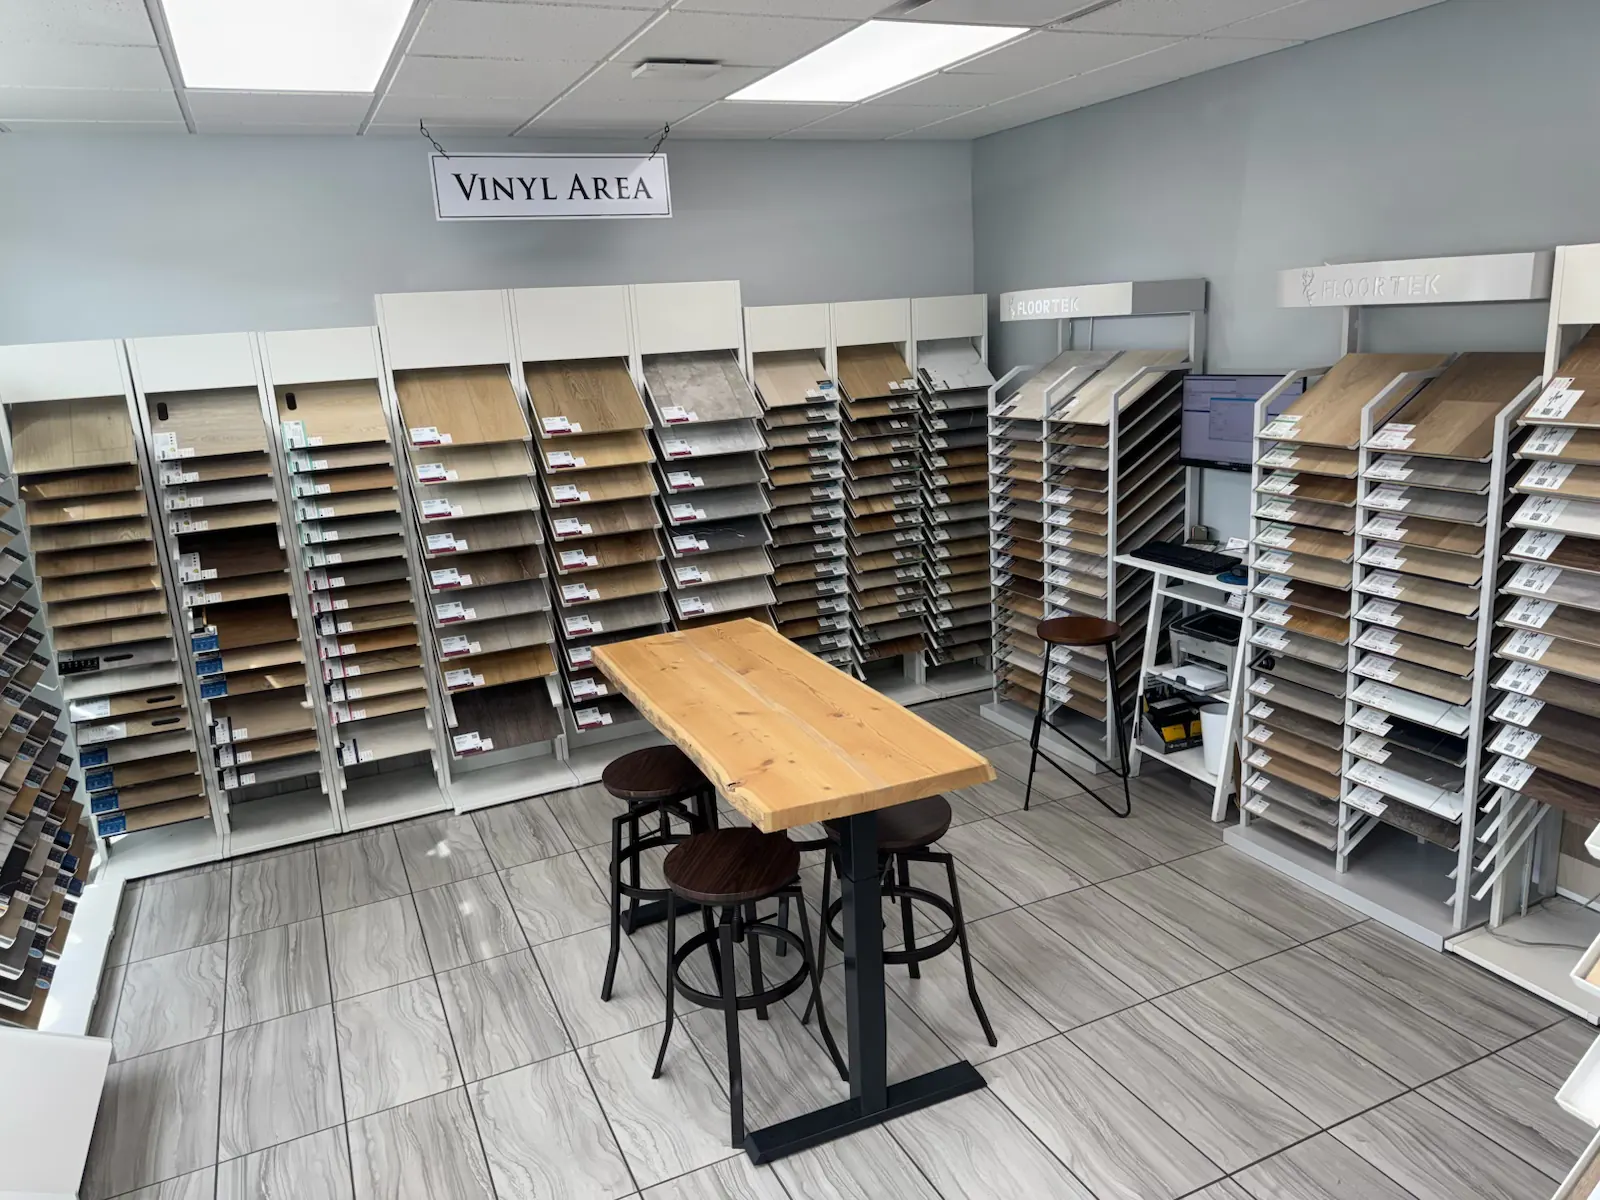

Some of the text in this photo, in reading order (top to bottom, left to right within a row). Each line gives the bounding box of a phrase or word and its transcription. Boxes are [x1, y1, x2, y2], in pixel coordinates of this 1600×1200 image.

[452, 173, 653, 201] VINYL AREA
[1322, 274, 1441, 298] FLOORTEK
[1017, 297, 1080, 316] FLOORTEK
